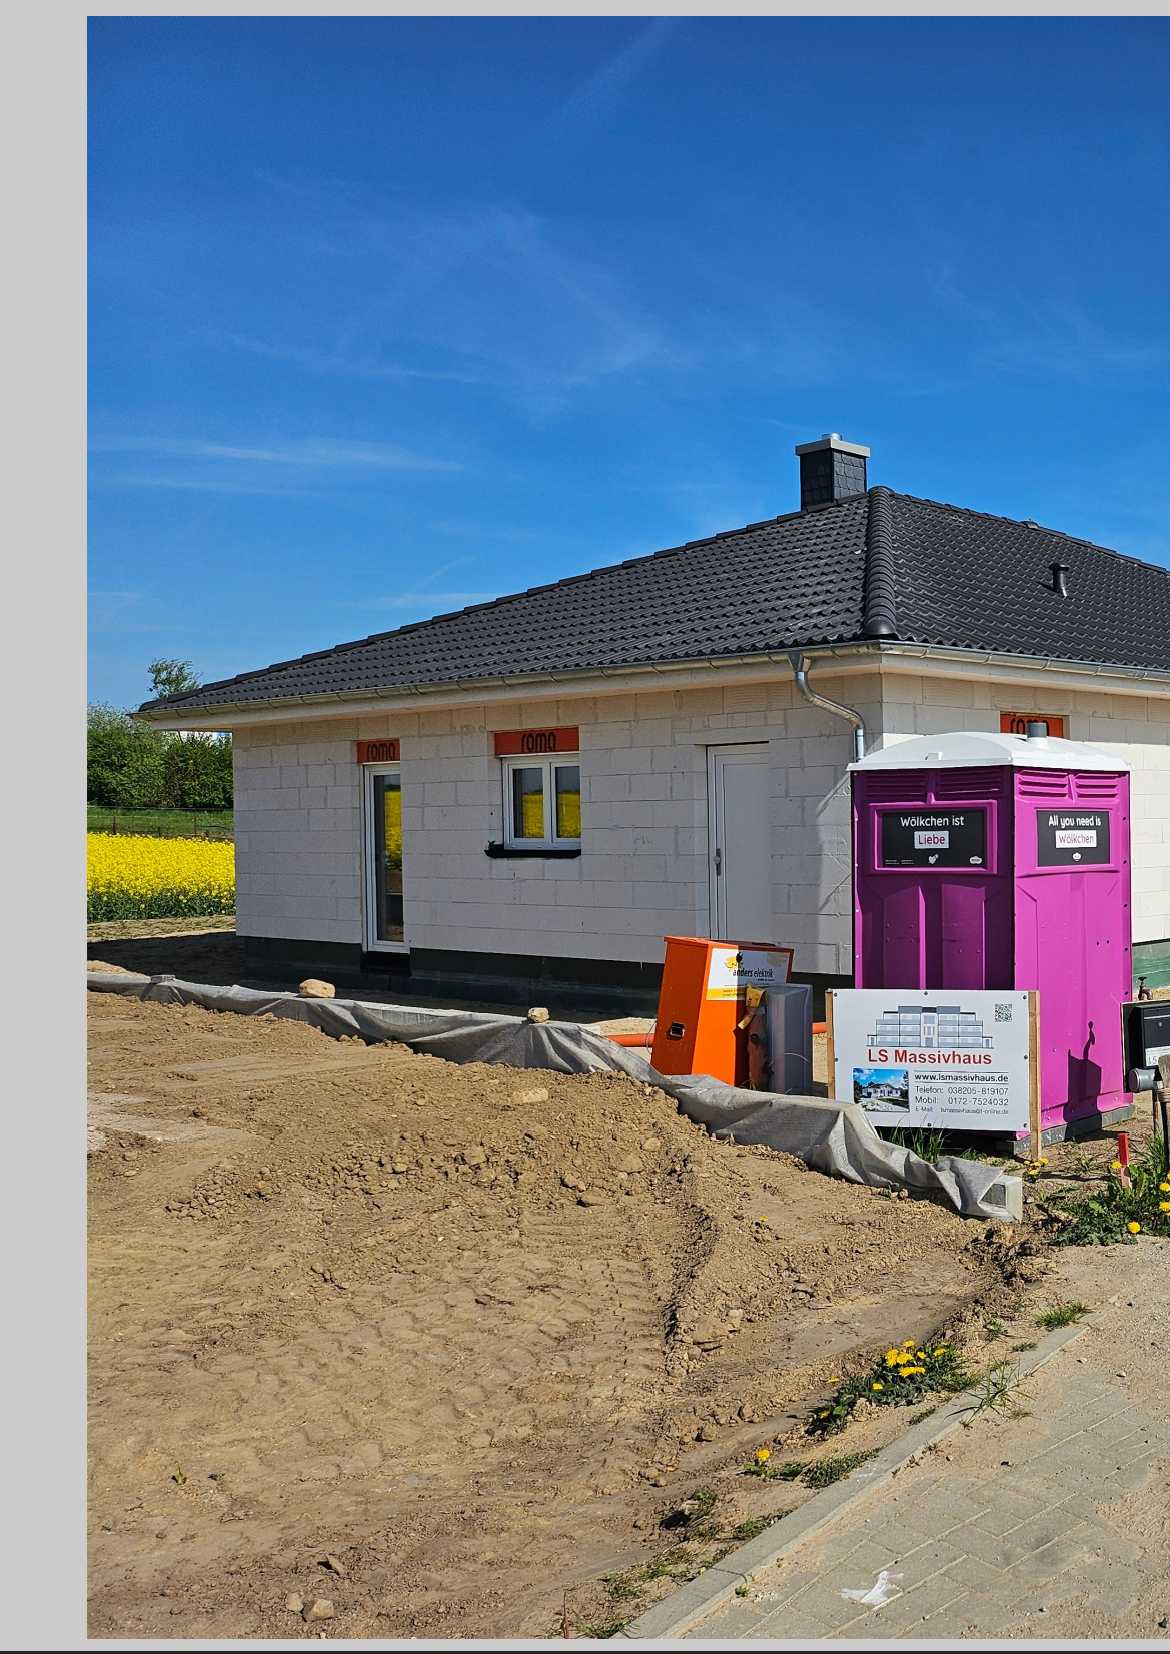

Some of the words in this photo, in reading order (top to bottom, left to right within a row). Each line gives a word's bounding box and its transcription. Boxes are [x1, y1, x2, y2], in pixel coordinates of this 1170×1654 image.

[521, 731, 556, 752] roma
[368, 742, 395, 761] roma
[900, 816, 949, 827] Wölkchen
[952, 816, 964, 826] ist
[1049, 815, 1058, 826] All
[1060, 817, 1074, 828] you
[1076, 816, 1094, 826] need
[1096, 815, 1101, 826] is
[918, 834, 945, 845] Liebe
[1059, 833, 1094, 844] Wölkchen
[868, 1049, 888, 1062] LS
[894, 1049, 992, 1065] Massivhaus
[914, 1073, 1008, 1082] www.lsmassivhaus.de
[915, 1086, 943, 1094] Telefon:
